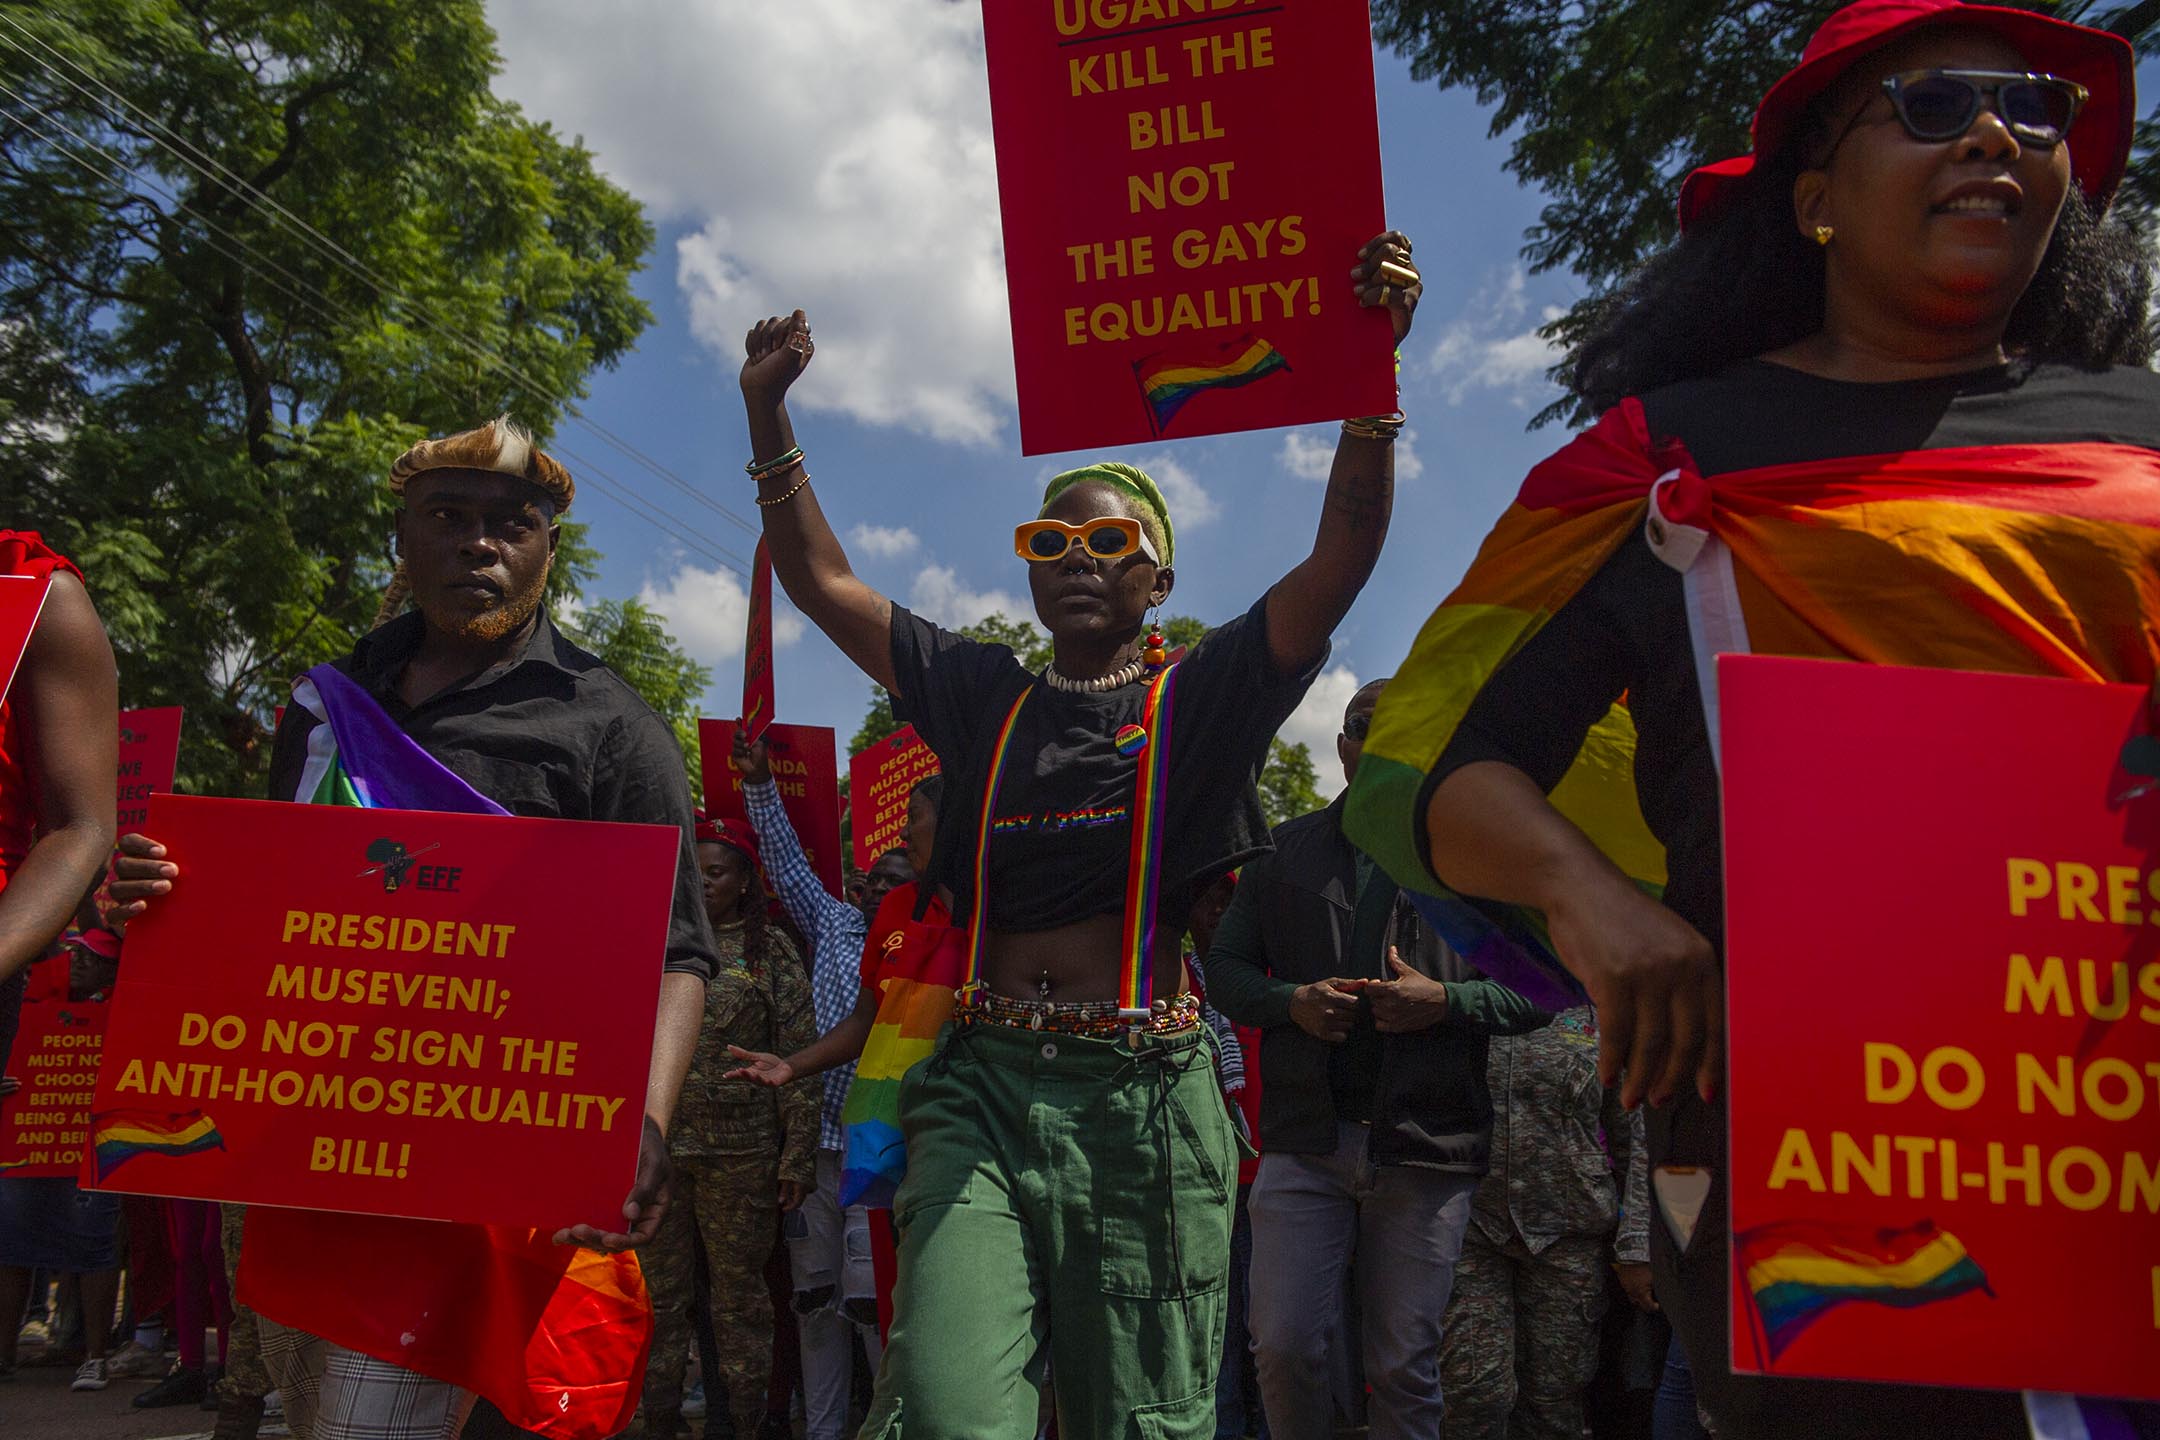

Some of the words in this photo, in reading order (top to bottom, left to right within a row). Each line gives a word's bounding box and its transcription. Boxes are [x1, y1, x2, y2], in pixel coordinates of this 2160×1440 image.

[1054, 0, 1256, 35] UGA
[1069, 47, 1168, 97] KILL
[1183, 27, 1274, 77] THE
[1129, 101, 1225, 149] BILL
[1129, 162, 1234, 213] NOT
[1067, 237, 1154, 282] THE
[1172, 215, 1306, 268] GAYS
[1065, 277, 1321, 345] EQUALITY!
[117, 760, 143, 776] WE
[727, 754, 808, 777] UNDA
[869, 766, 909, 797] MUST
[865, 814, 909, 847] BEING
[869, 835, 903, 862] AND
[416, 865, 463, 889] EFF
[282, 910, 516, 958] PRESIDENT
[266, 963, 511, 1020] MUSEVENI;
[43, 1034, 102, 1048] PEOPLE
[178, 1012, 247, 1050] DO
[261, 1018, 359, 1059] NOT
[370, 1027, 484, 1069] SIGN
[500, 1036, 578, 1076] THE
[28, 1054, 75, 1067] MUST
[1864, 1041, 1986, 1110] DO
[34, 1073, 96, 1086] CHOOS
[115, 1059, 625, 1132] ANTI-HOMOSEXUALITY
[14, 1112, 66, 1125] BEING
[16, 1132, 55, 1144] AND
[29, 1151, 48, 1164] IN
[310, 1136, 411, 1179] BILL!
